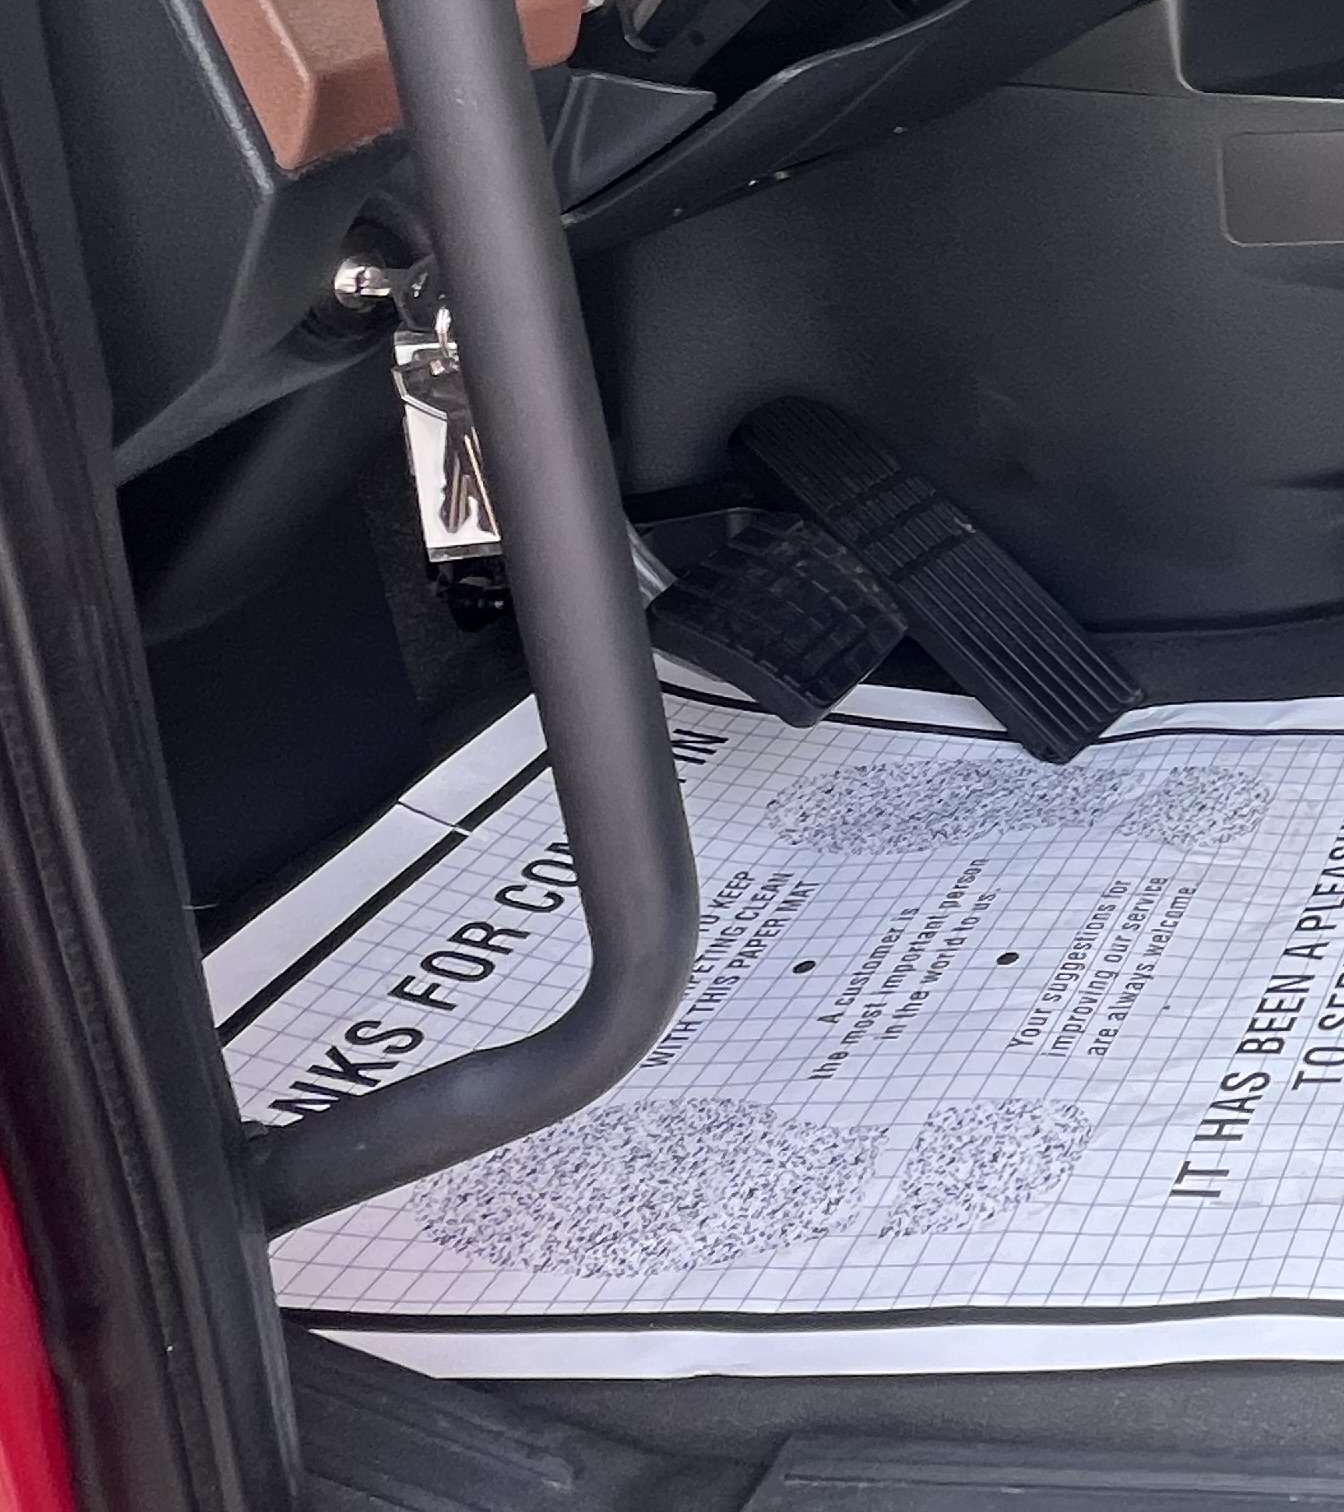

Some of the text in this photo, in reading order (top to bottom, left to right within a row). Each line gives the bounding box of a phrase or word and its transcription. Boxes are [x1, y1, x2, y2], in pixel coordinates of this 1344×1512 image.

[707, 871, 756, 909] KEEP
[735, 872, 795, 921] CLEAN
[641, 881, 820, 1068] WITH THIS PAPER MAT
[808, 859, 989, 1079] the most important person
[817, 907, 919, 1024] A customer is
[874, 1025, 907, 1040] in
[892, 991, 929, 1018] the
[920, 937, 967, 984] world
[951, 916, 980, 932] to
[1006, 880, 1131, 1048] Your suggestions for
[1041, 877, 1168, 1057] improving our service
[1283, 941, 1330, 960] A
[268, 1020, 425, 1116] NKS
[388, 921, 530, 1011] FOR
[1087, 1028, 1119, 1055] are
[1108, 963, 1155, 1021] always
[1234, 975, 1315, 1055] BEEN
[1193, 1072, 1271, 1141] HAS
[1170, 1161, 1230, 1198] IT
